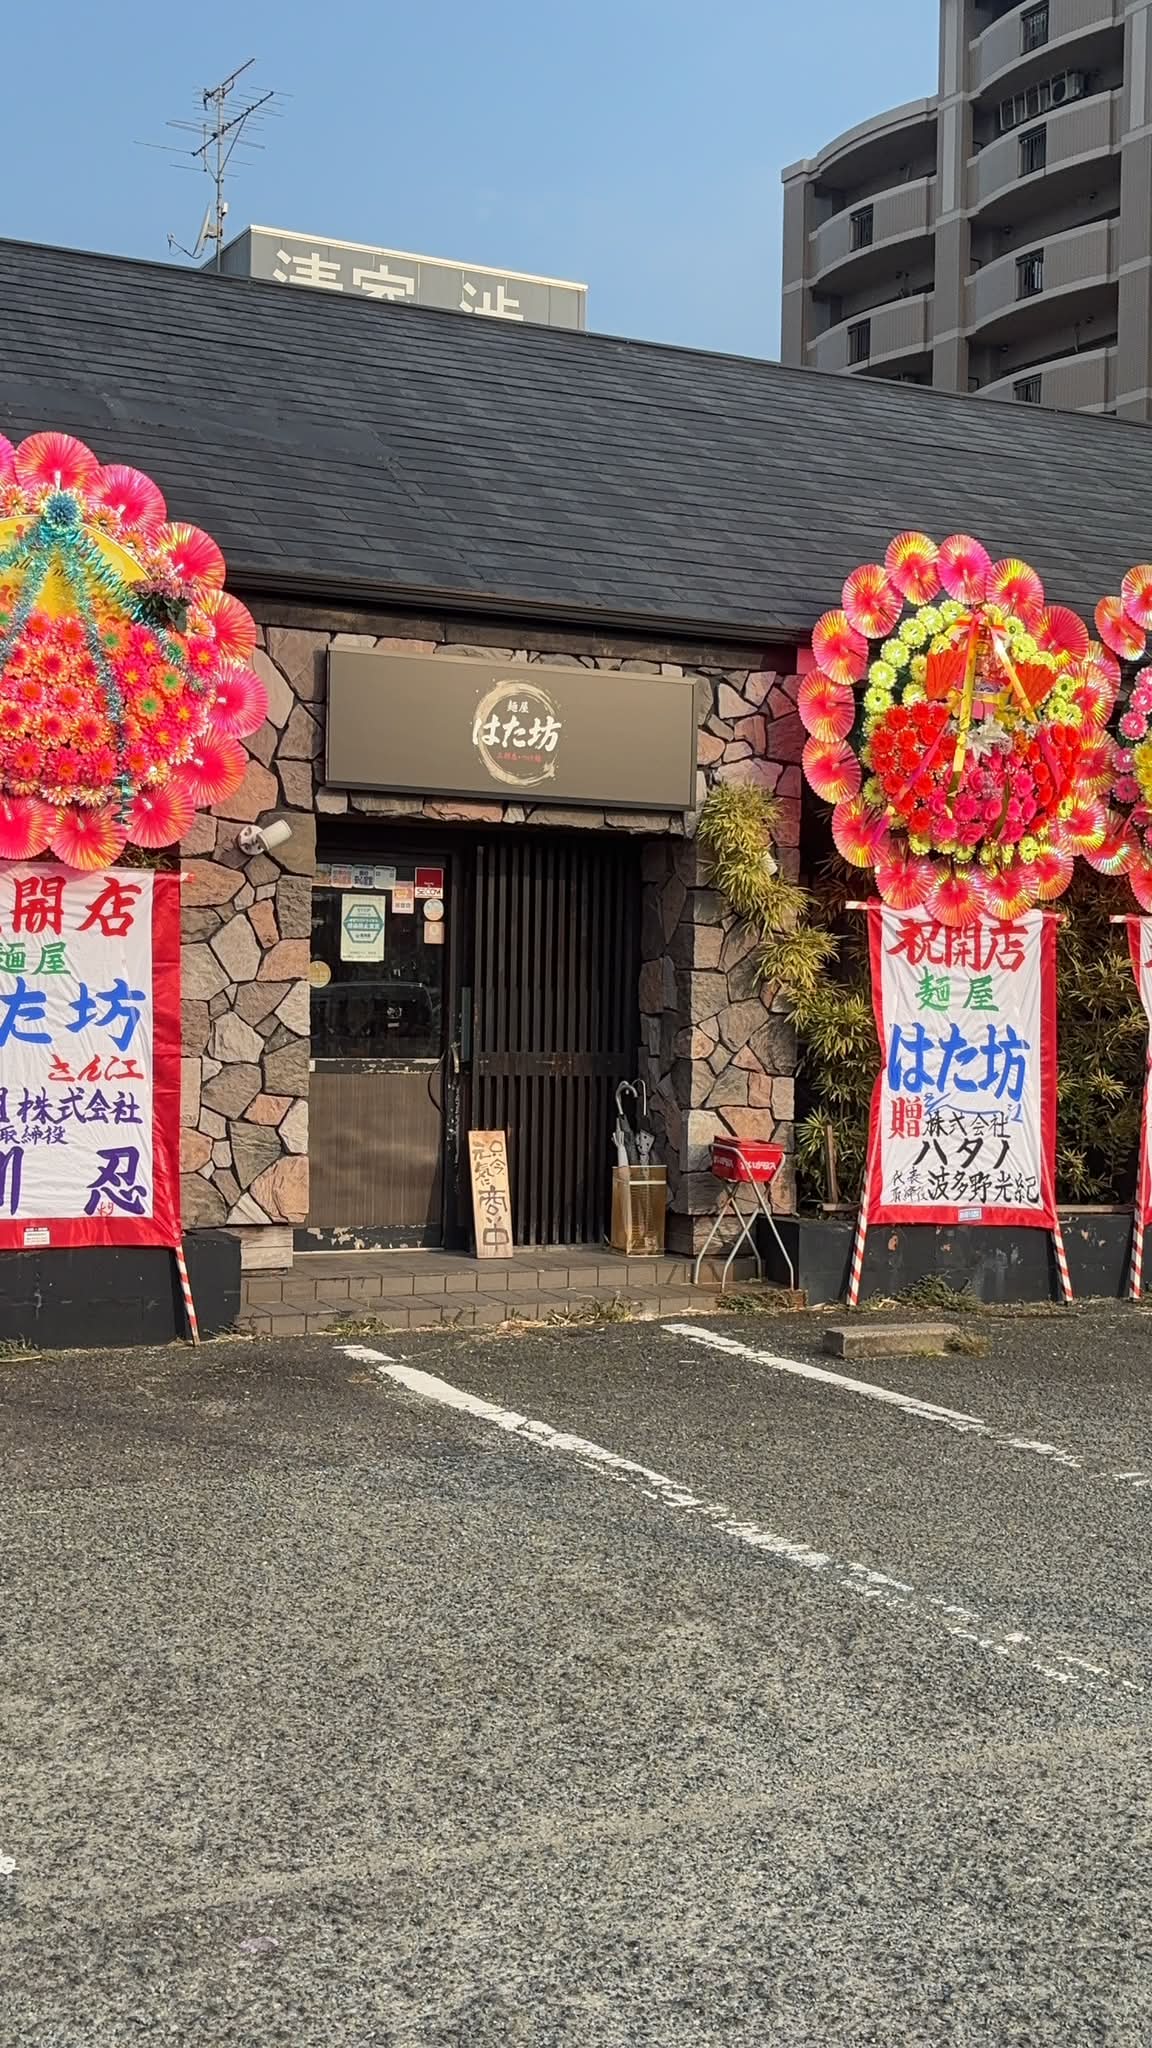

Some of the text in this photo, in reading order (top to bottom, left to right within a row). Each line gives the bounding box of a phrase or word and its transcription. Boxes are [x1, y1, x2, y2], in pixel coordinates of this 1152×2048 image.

[472, 714, 562, 752] はた坊
[886, 918, 1029, 972] 祝開店
[914, 966, 1000, 1012] 麺屋
[48, 1054, 145, 1082] さん江
[887, 1022, 1030, 1101] はた坊
[888, 1096, 923, 1140] 贈
[922, 1110, 1011, 1139] 株式会社
[912, 1138, 1010, 1170] ハタノ
[83, 1146, 147, 1216] 忍
